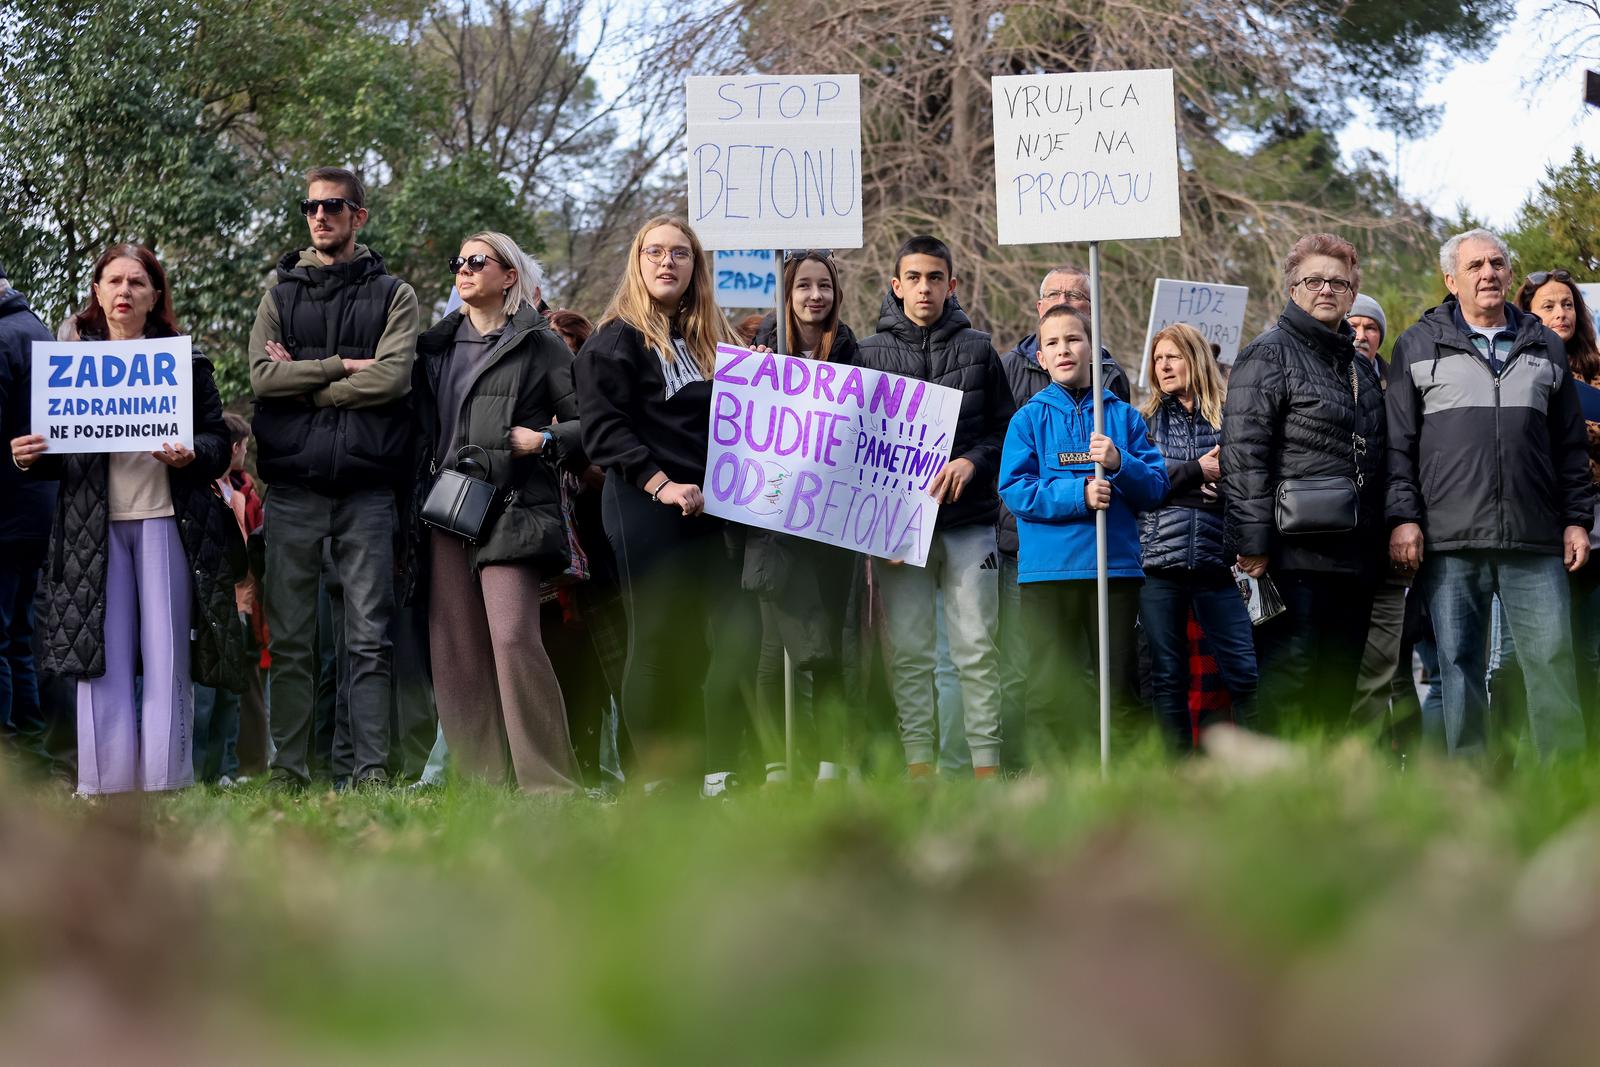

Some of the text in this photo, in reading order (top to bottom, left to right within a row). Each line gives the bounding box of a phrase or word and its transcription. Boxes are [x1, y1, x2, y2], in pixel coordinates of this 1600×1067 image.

[718, 81, 841, 120] STOP
[1016, 128, 1135, 162] NIJE NA
[693, 143, 855, 222] BETONU
[1013, 171, 1152, 216] PRODAJU
[48, 352, 178, 388] ZADAR
[714, 345, 926, 423] ZADRANI
[48, 395, 177, 416] ZADRANIMA!
[50, 422, 179, 439] NE POJEDINCIMA
[713, 391, 851, 467] BUDITE
[712, 451, 923, 561] OD BETONA
